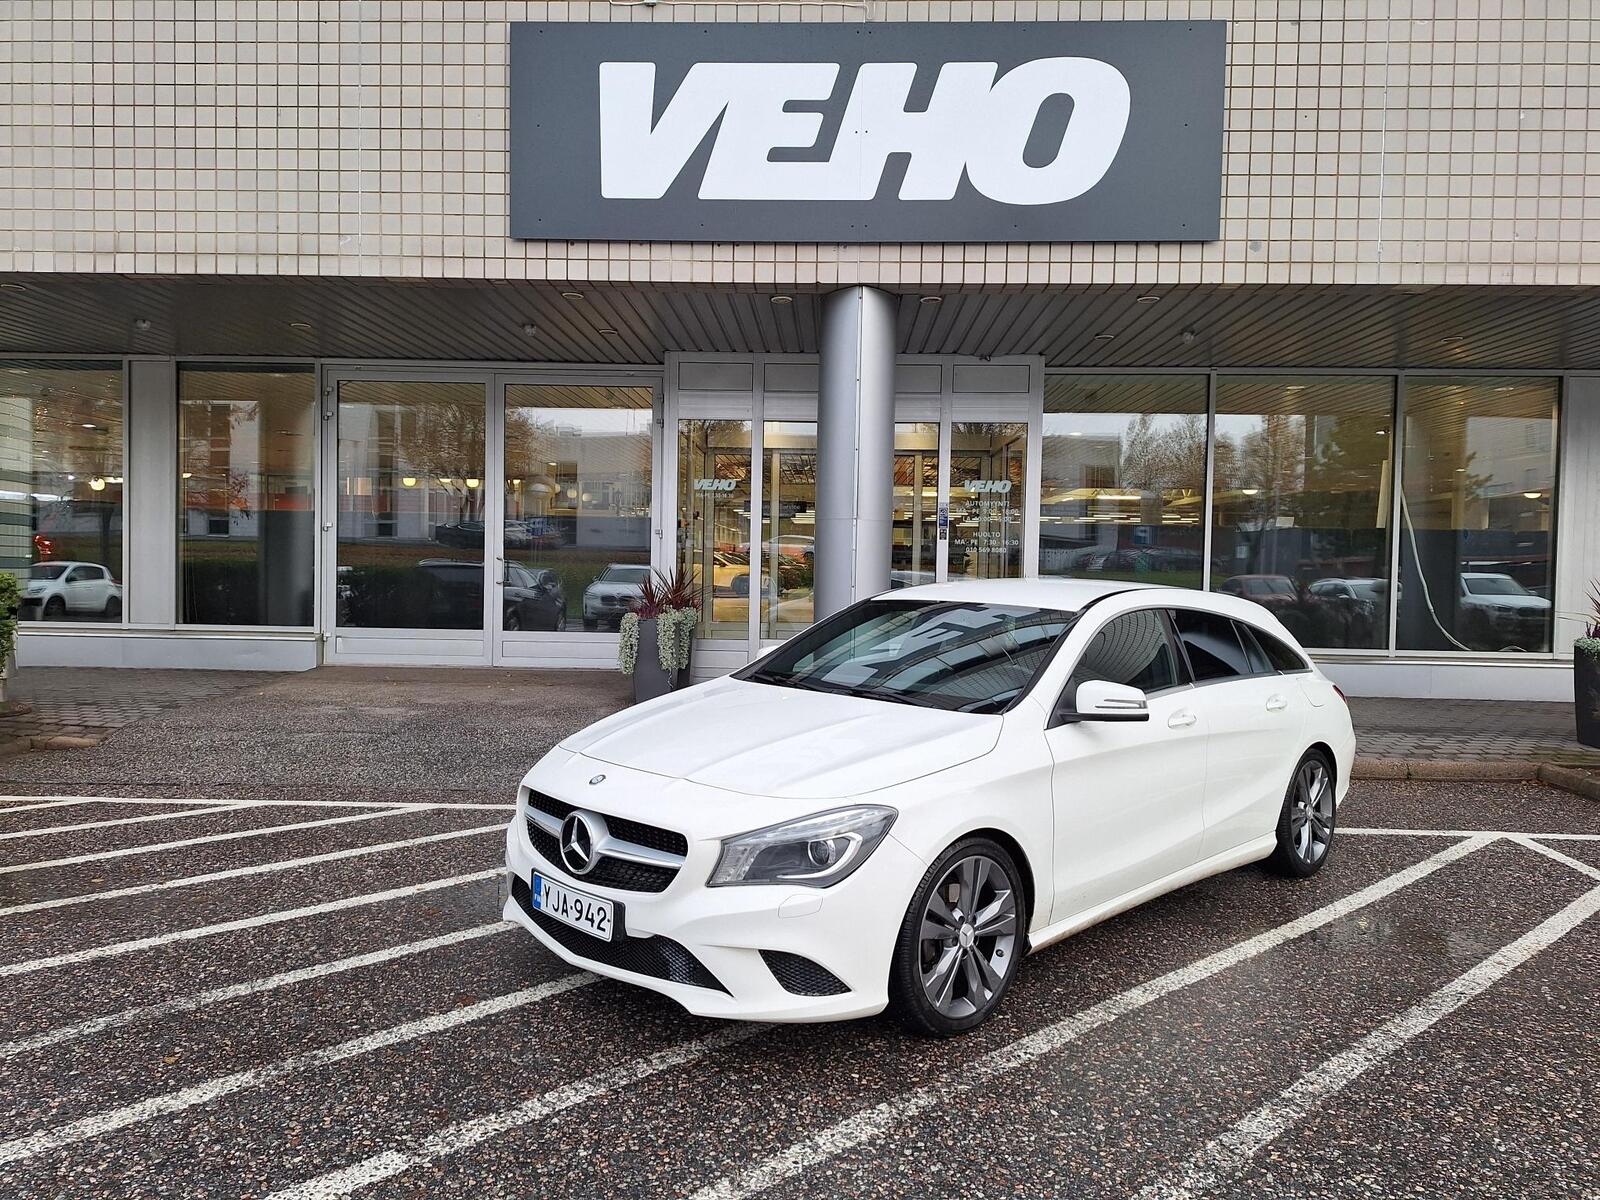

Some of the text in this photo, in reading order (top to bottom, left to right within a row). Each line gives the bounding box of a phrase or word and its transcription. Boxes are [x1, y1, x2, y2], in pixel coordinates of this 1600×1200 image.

[599, 56, 1131, 205] VEHO
[693, 479, 737, 491] VEHO
[964, 480, 1012, 493] VEHO
[544, 884, 606, 932] YJA-942
